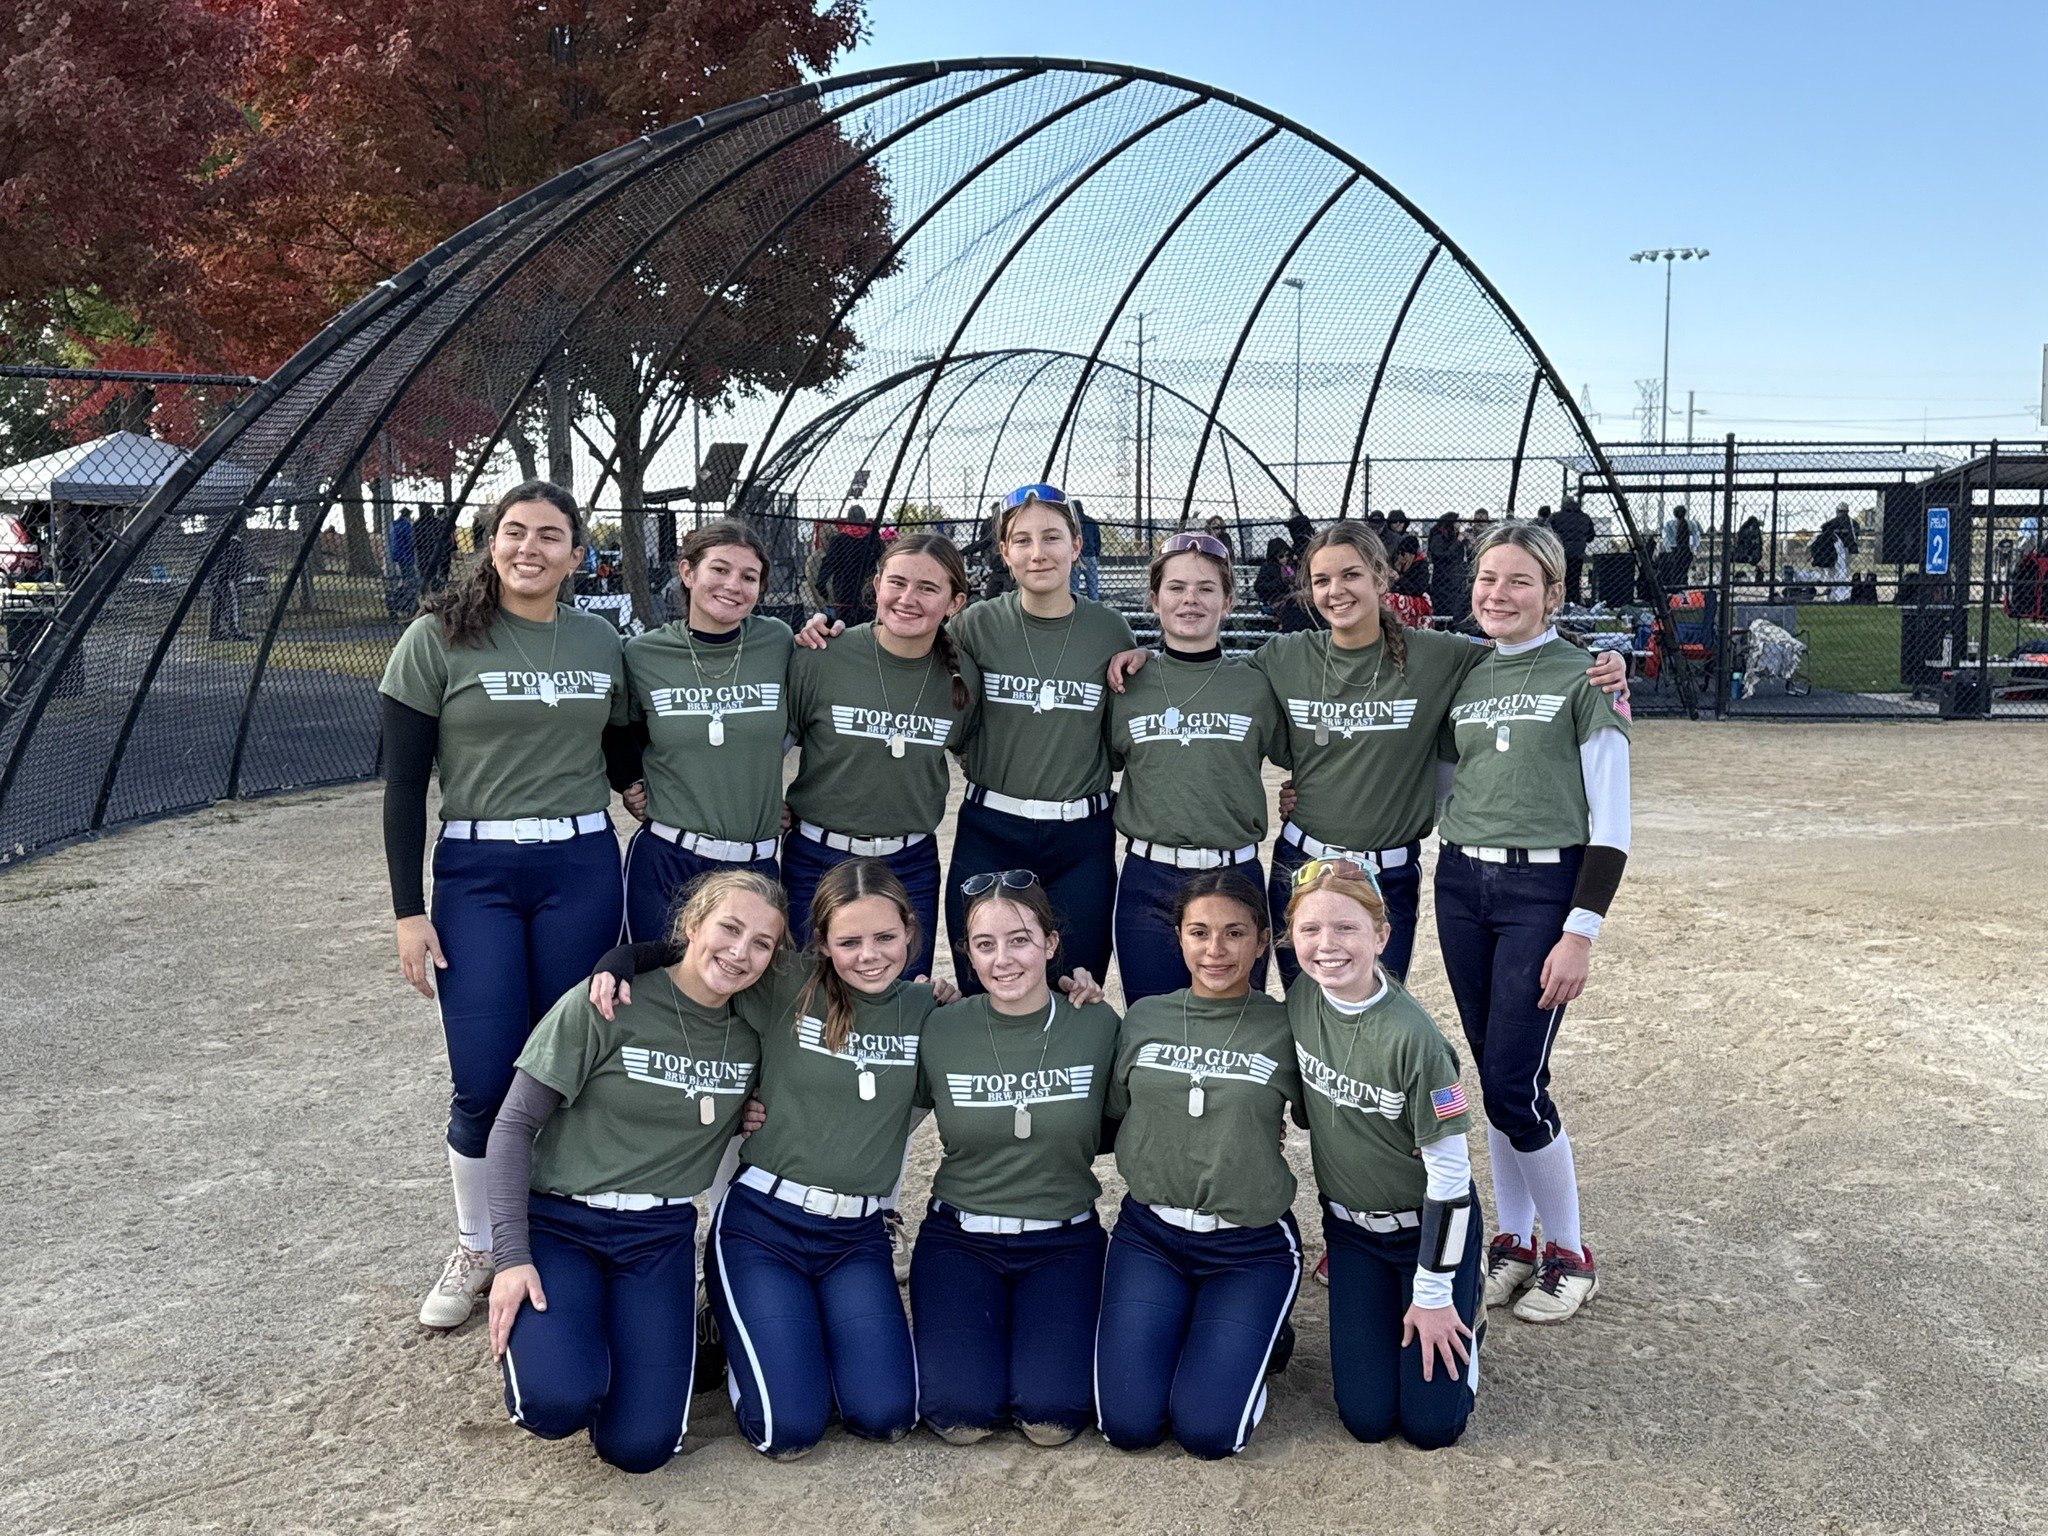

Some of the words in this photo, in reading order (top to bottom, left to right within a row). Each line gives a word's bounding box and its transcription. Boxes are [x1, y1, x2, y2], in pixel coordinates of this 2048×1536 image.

[1932, 535, 1943, 564] 2
[508, 671, 549, 687] TOP
[553, 671, 594, 687] GUN
[1000, 674, 1040, 693] TOP
[556, 686, 579, 694] LAST
[672, 687, 713, 703] TOP
[716, 684, 762, 702] GUN
[1012, 691, 1035, 701] BRW
[687, 702, 709, 711] BRW
[712, 701, 744, 711] BLAST
[1310, 701, 1347, 718] TOP
[1349, 701, 1393, 719] GUN
[1463, 697, 1498, 713] TOP
[1497, 693, 1541, 711] GUN
[854, 707, 893, 727] TOP
[895, 713, 935, 733] GUN
[1187, 713, 1230, 728] GUN
[1342, 718, 1375, 727] BLAST
[866, 724, 888, 735] BRW
[1159, 727, 1180, 735] BRW
[1181, 727, 1212, 735] BLAST
[862, 1034, 904, 1052] GUN
[857, 1049, 888, 1060] BLAST
[1161, 1044, 1203, 1063] TOP
[1204, 1048, 1254, 1068] GUN
[651, 1050, 692, 1074] TOP
[694, 1060, 739, 1080] GUN
[1170, 1060, 1195, 1071] BRW
[1195, 1063, 1230, 1075] BLAST
[664, 1070, 688, 1083] BRW
[689, 1076, 721, 1088] BLAST
[972, 1073, 1017, 1093] TOP
[1021, 1068, 1071, 1090] GUN
[1306, 1054, 1337, 1083] TOP
[1337, 1074, 1381, 1104] GUN
[988, 1092, 1013, 1102] BRW
[1015, 1088, 1051, 1100] BLAST
